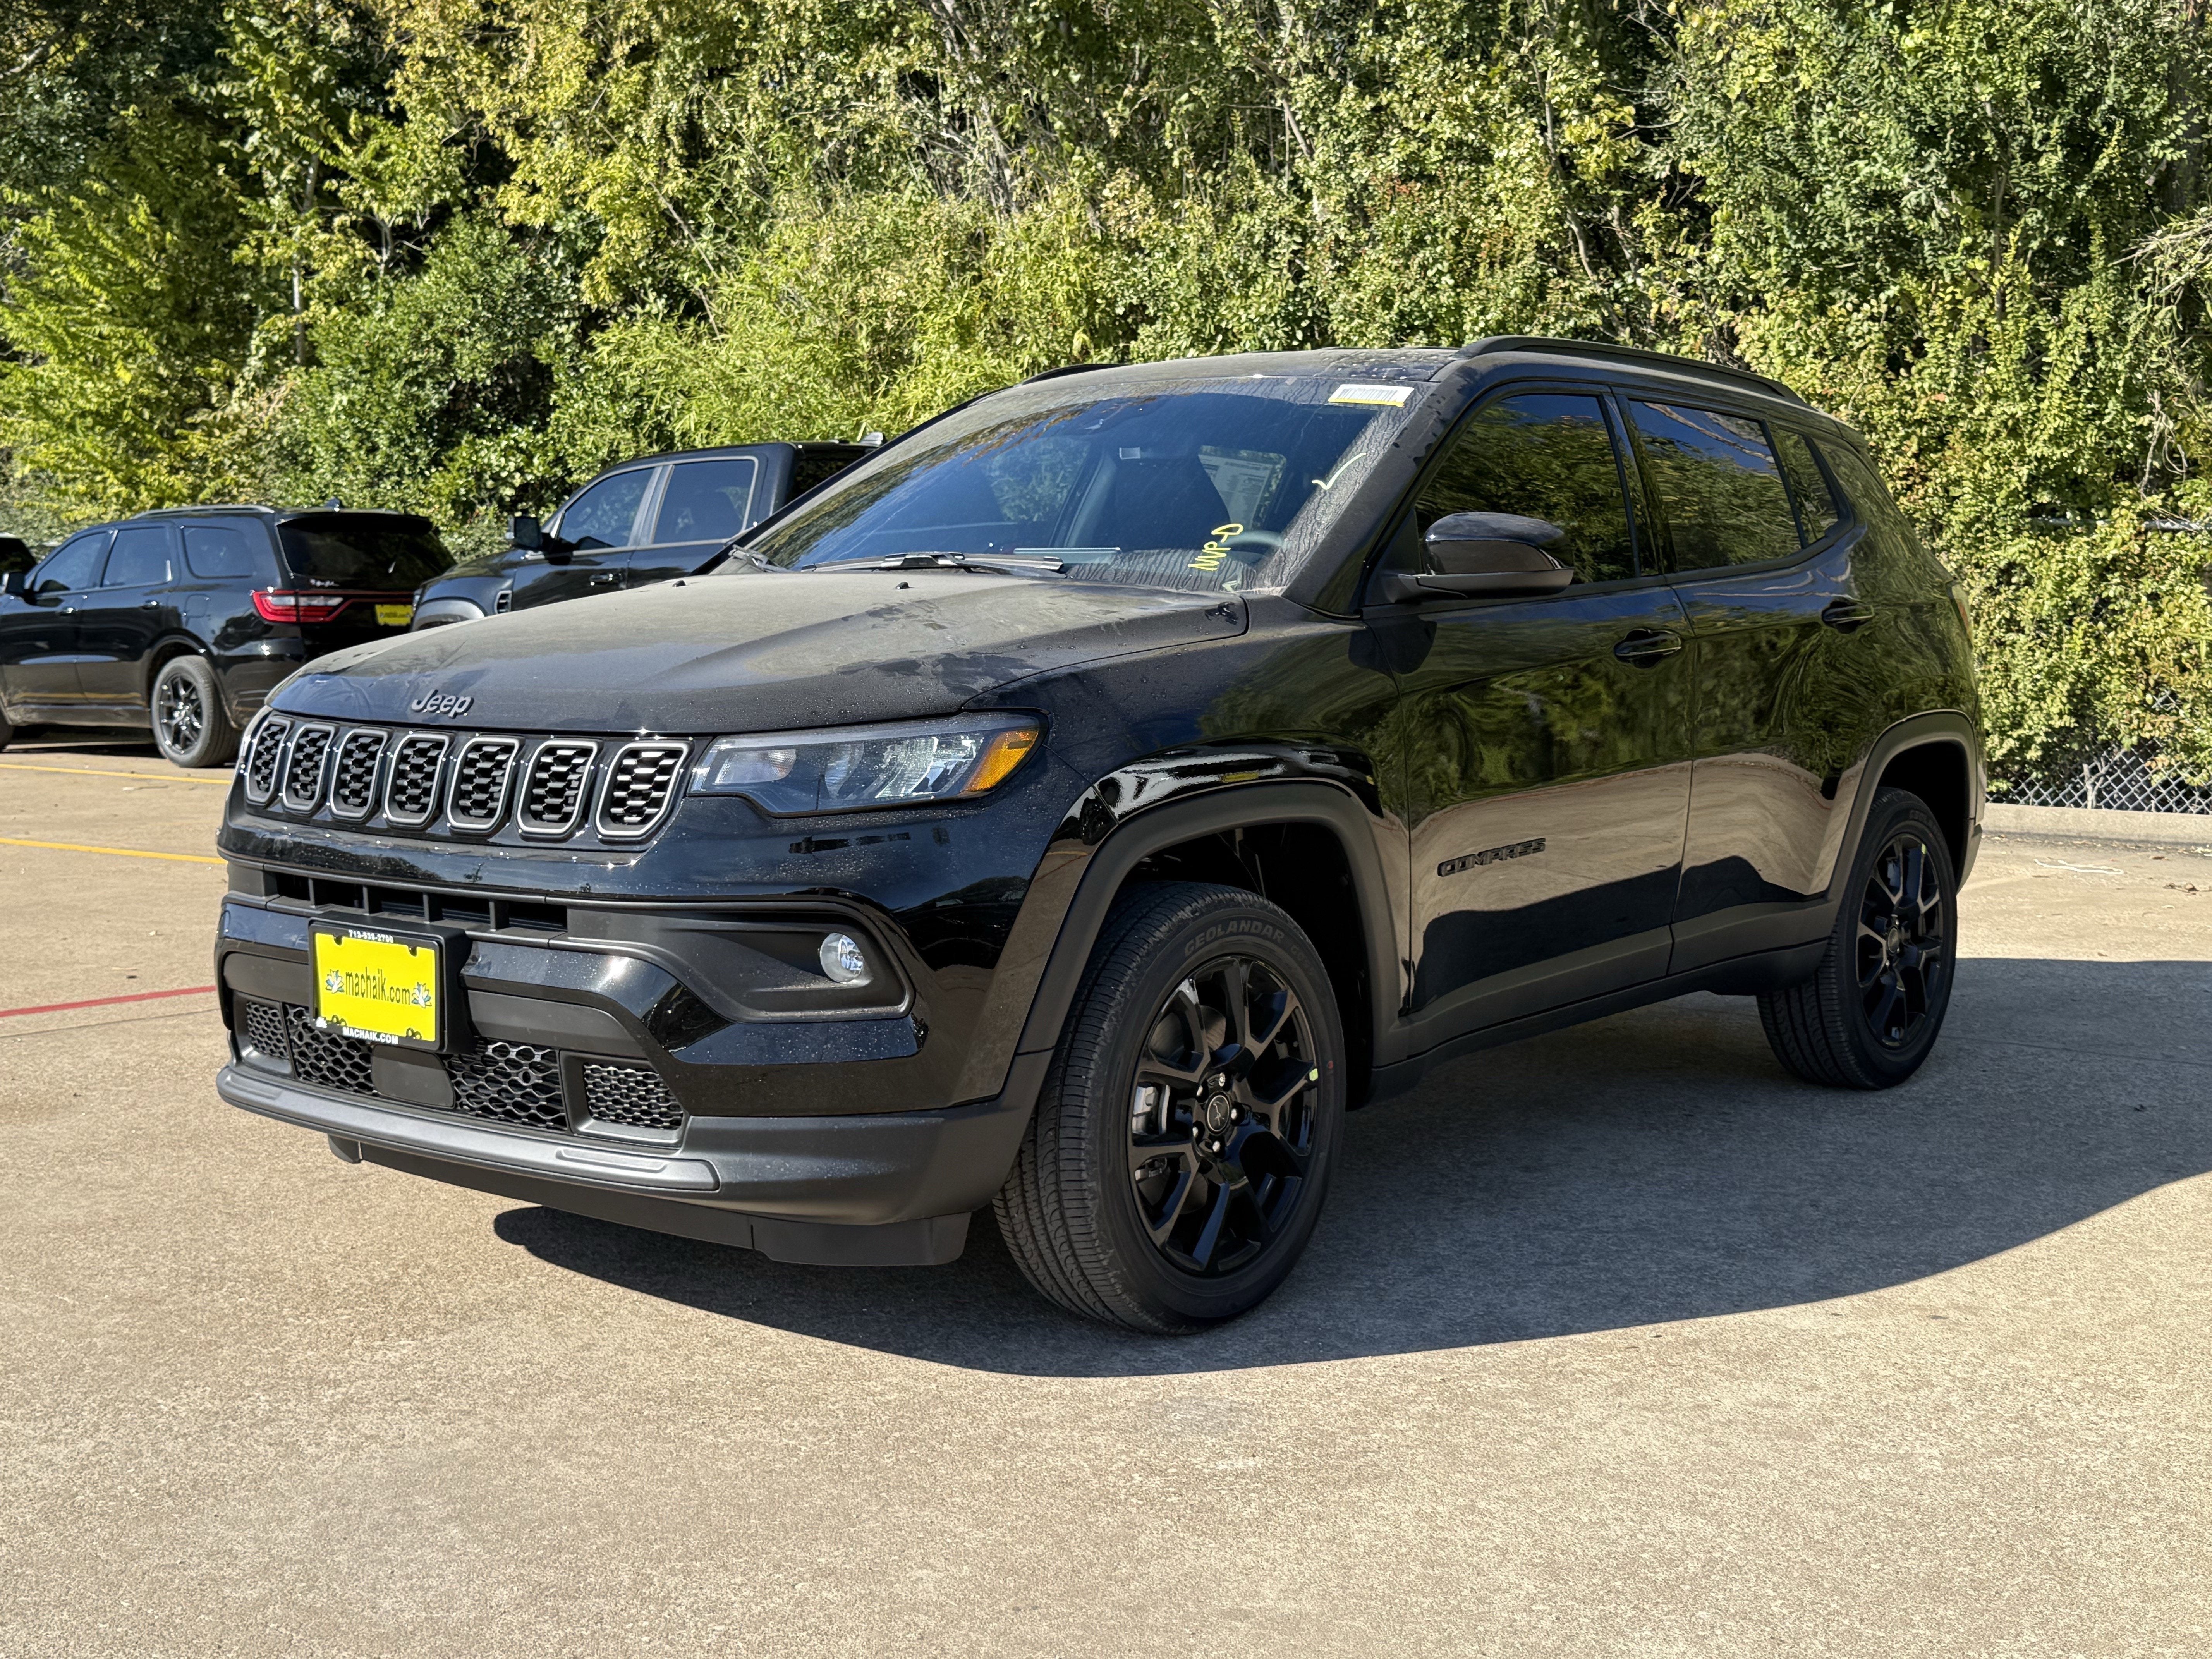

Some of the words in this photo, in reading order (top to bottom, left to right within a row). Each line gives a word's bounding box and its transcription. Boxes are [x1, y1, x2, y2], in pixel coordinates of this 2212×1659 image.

[411, 689, 474, 719] Jeep
[1437, 838, 1546, 877] COMPASS
[1185, 921, 1285, 956] GEOLANDAR
[345, 967, 410, 1005] machaik.com
[343, 1027, 398, 1044] MACHAIK.COM
